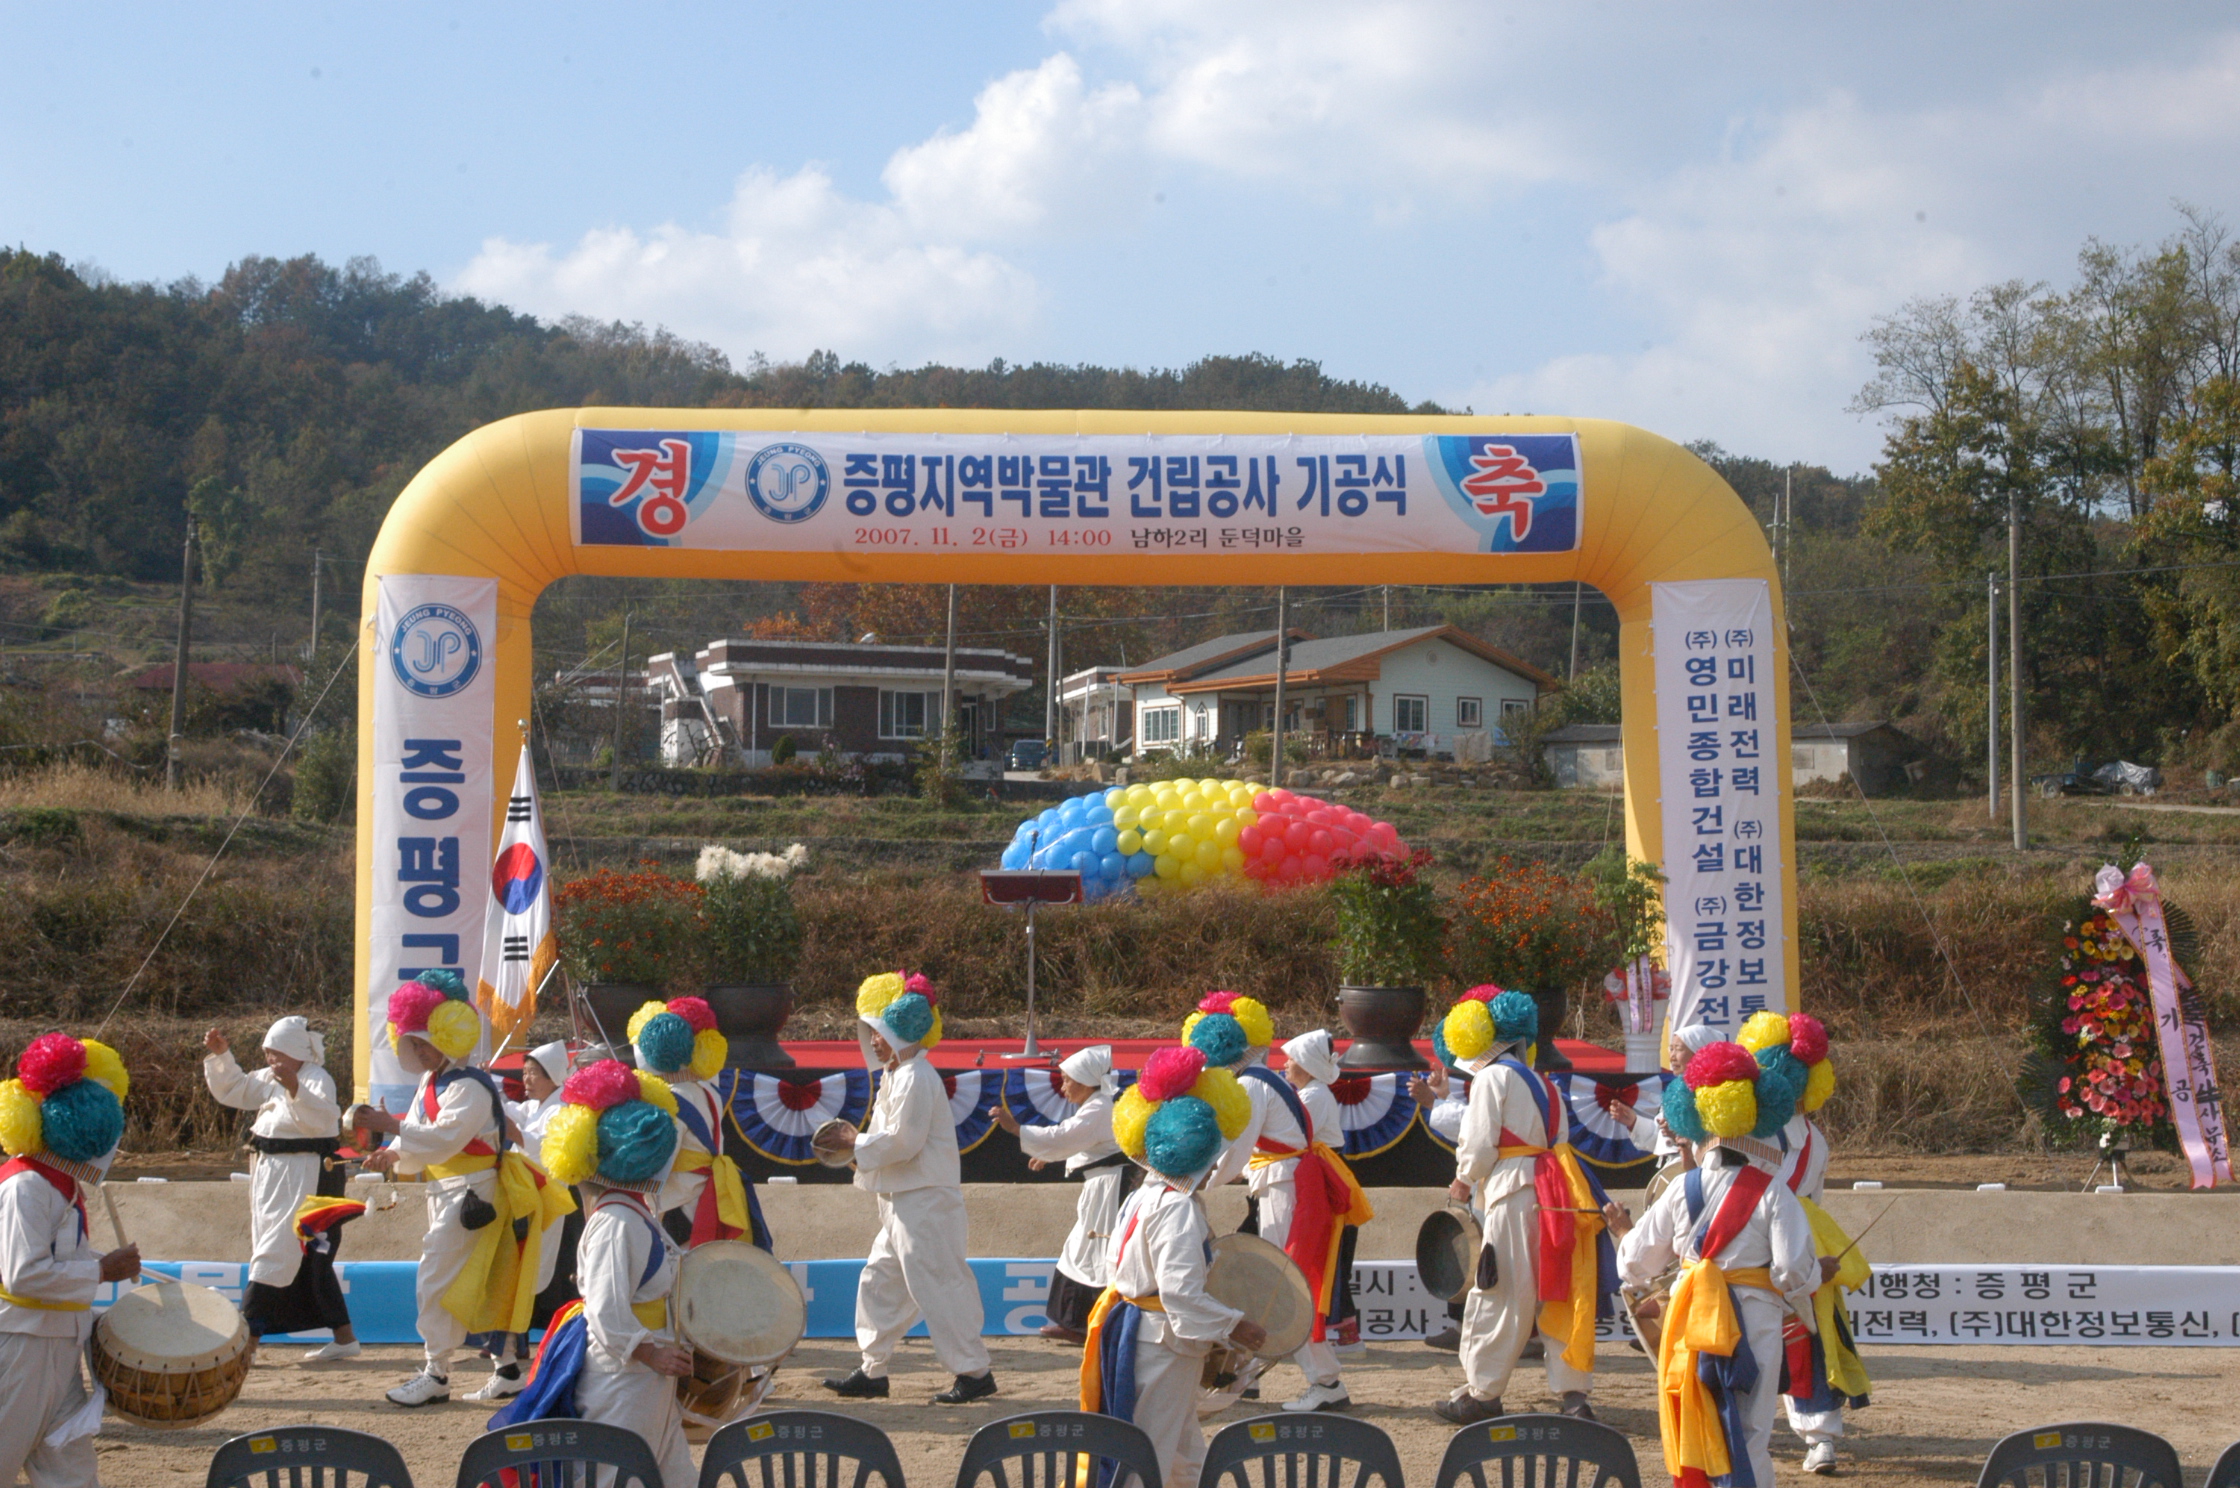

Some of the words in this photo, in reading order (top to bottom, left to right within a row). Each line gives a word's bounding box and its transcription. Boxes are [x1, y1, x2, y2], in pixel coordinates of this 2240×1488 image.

[613, 440, 691, 535] 경
[757, 446, 783, 466] JEUNG
[788, 446, 820, 467] PYEONG
[843, 453, 1110, 518] 증평지역박물관
[1127, 454, 1279, 518] 건립공사
[1297, 454, 1407, 517] 기공식
[1464, 445, 1544, 537] 축
[855, 527, 918, 546] 2007.
[932, 527, 957, 546] 11.
[973, 527, 1028, 549] 2(금)
[1049, 529, 1110, 546] 14:00
[1131, 527, 1207, 548] 남하2리
[1219, 527, 1305, 548] 둔덕마을
[401, 608, 430, 632] JEUNG
[436, 608, 472, 635] PYEONG
[1693, 896, 1730, 1042] (주)금강전
